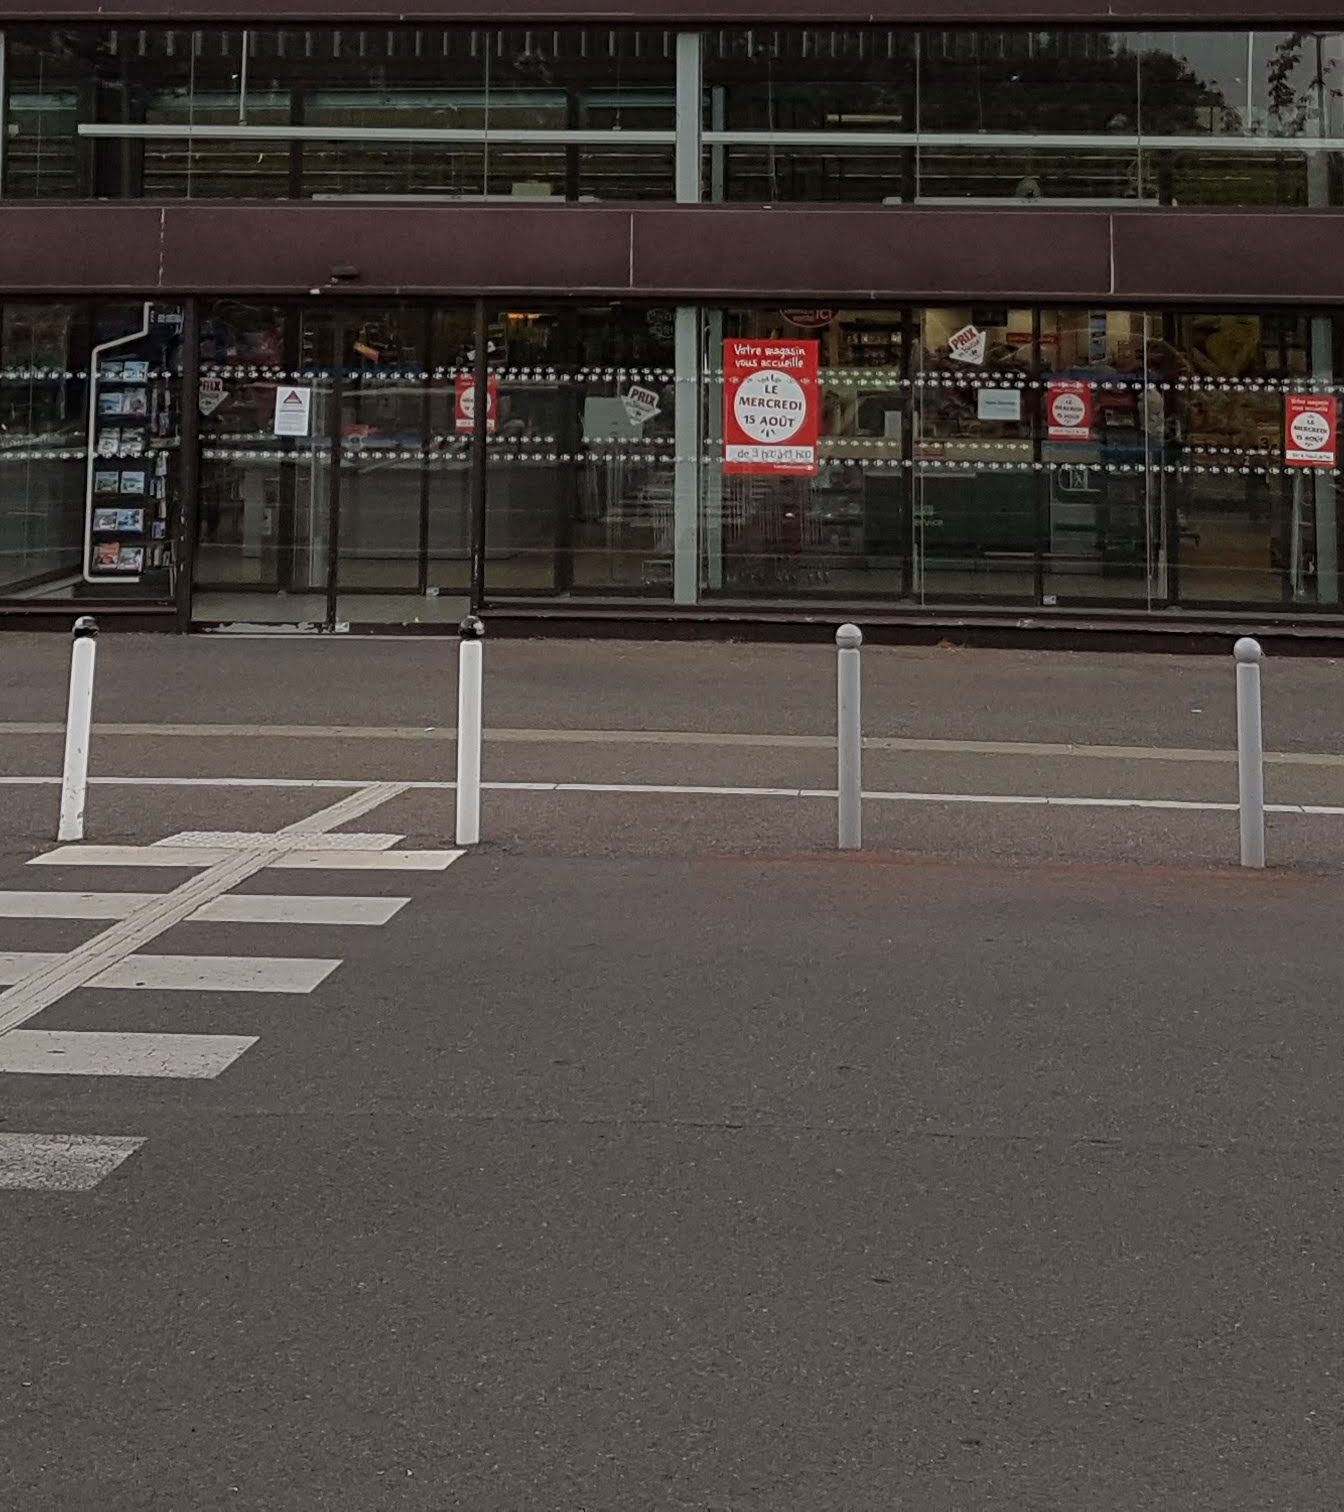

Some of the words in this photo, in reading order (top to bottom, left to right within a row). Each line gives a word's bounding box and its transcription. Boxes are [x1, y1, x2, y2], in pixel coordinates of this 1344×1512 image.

[950, 328, 977, 350] PRIX
[734, 344, 762, 356] Votre
[764, 347, 805, 359] magasin
[735, 359, 758, 368] vous
[760, 357, 804, 368] accueille
[765, 384, 778, 394] LE
[630, 389, 656, 407] PRIX
[738, 396, 802, 411] MERCREDI
[744, 415, 755, 425] 15
[760, 415, 795, 428] AOÛT
